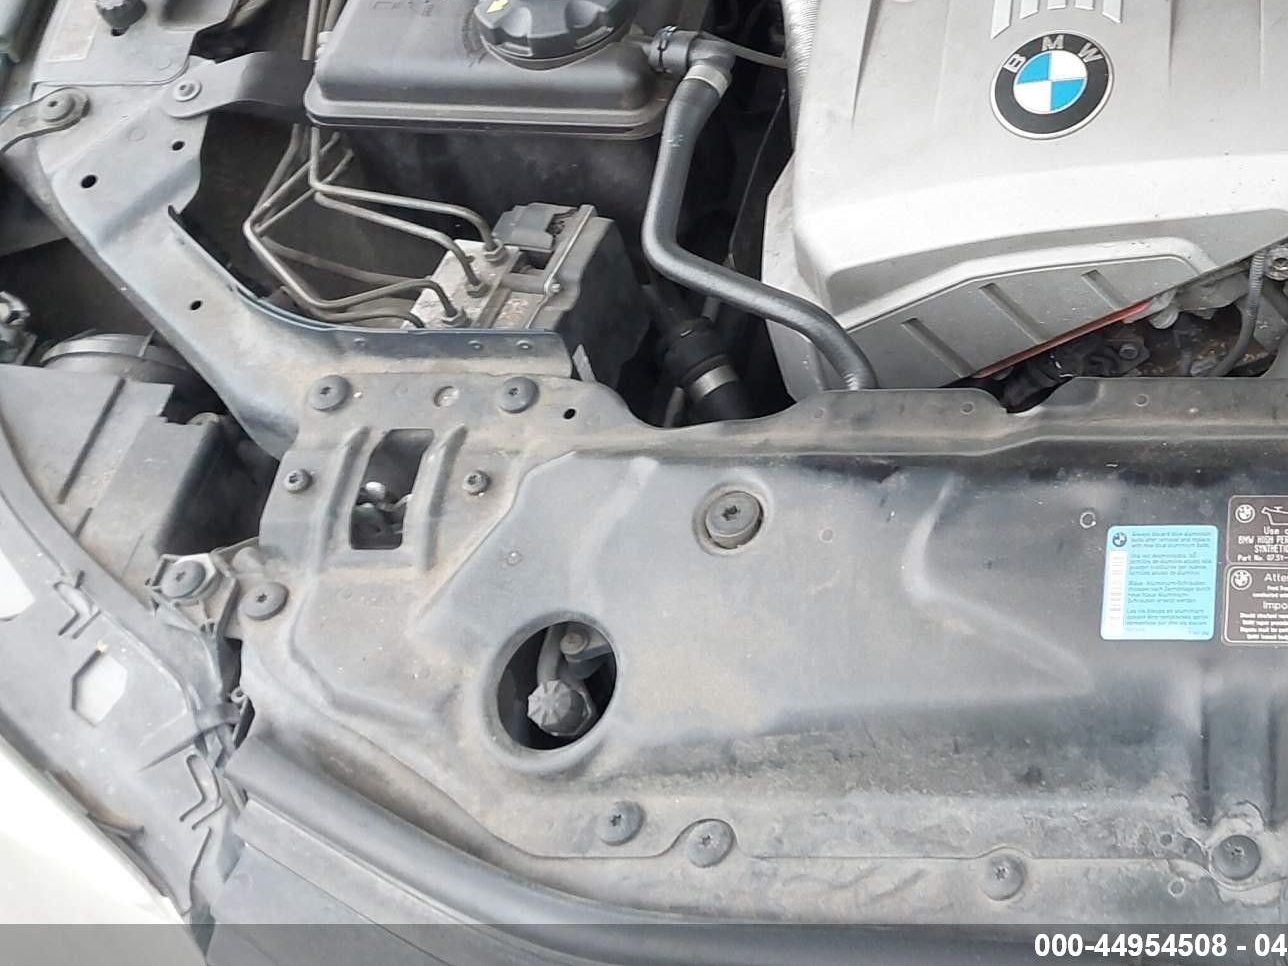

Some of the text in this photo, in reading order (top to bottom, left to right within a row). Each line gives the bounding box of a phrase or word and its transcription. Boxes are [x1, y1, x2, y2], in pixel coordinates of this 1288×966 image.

[1002, 34, 1103, 74] BMW
[1263, 526, 1280, 535] Use
[1238, 535, 1254, 544] BMW
[1257, 535, 1274, 544] HIGH
